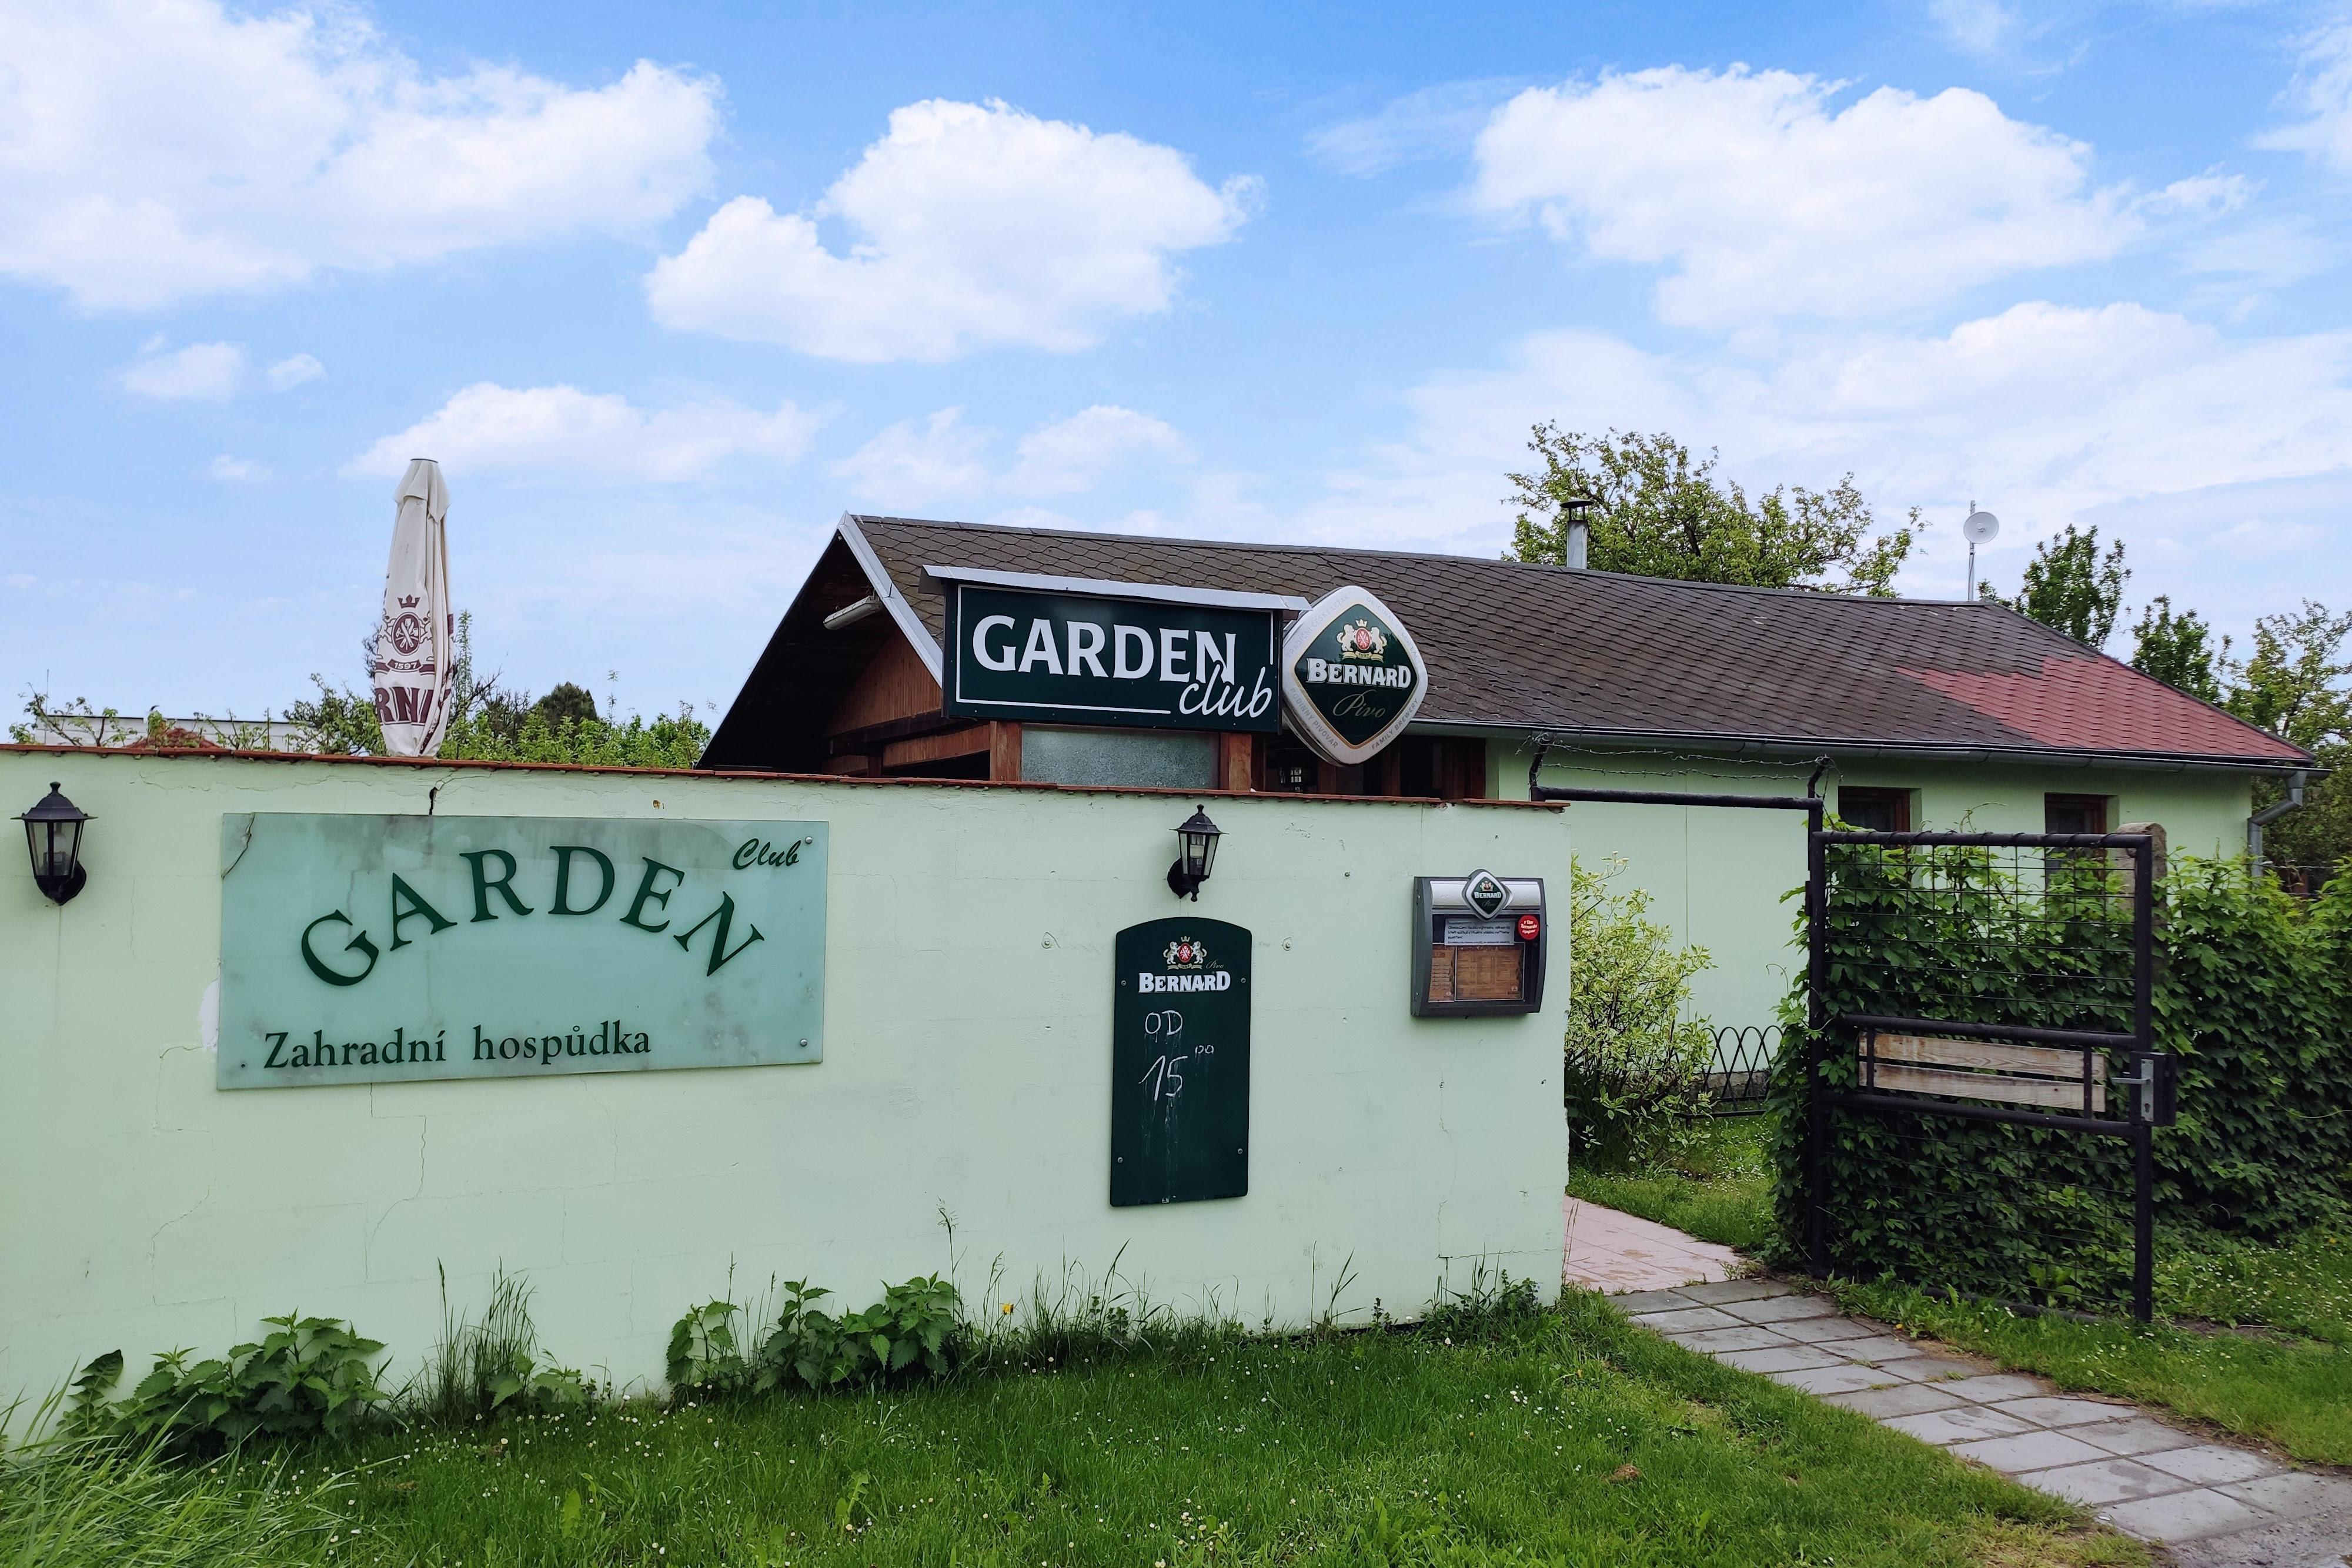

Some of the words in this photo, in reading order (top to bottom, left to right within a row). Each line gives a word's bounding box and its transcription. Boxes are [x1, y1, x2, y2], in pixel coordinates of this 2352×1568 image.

[972, 614, 1237, 685] GARDEN
[1179, 664, 1272, 718] club
[1305, 657, 1411, 690] BERNARD
[1332, 689, 1386, 718] Pivo
[1312, 720, 1338, 748] PIVOVAR
[1372, 729, 1393, 750] FAMILY
[1394, 698, 1418, 731] BREWERY
[733, 838, 801, 870] Club
[300, 845, 765, 987] GARDEN
[1138, 971, 1231, 994] BERNARD
[1144, 1009, 1183, 1035] OD
[263, 1027, 446, 1070] Zahradní
[472, 1019, 652, 1065] hospůdka
[1138, 1055, 1188, 1101] 15
